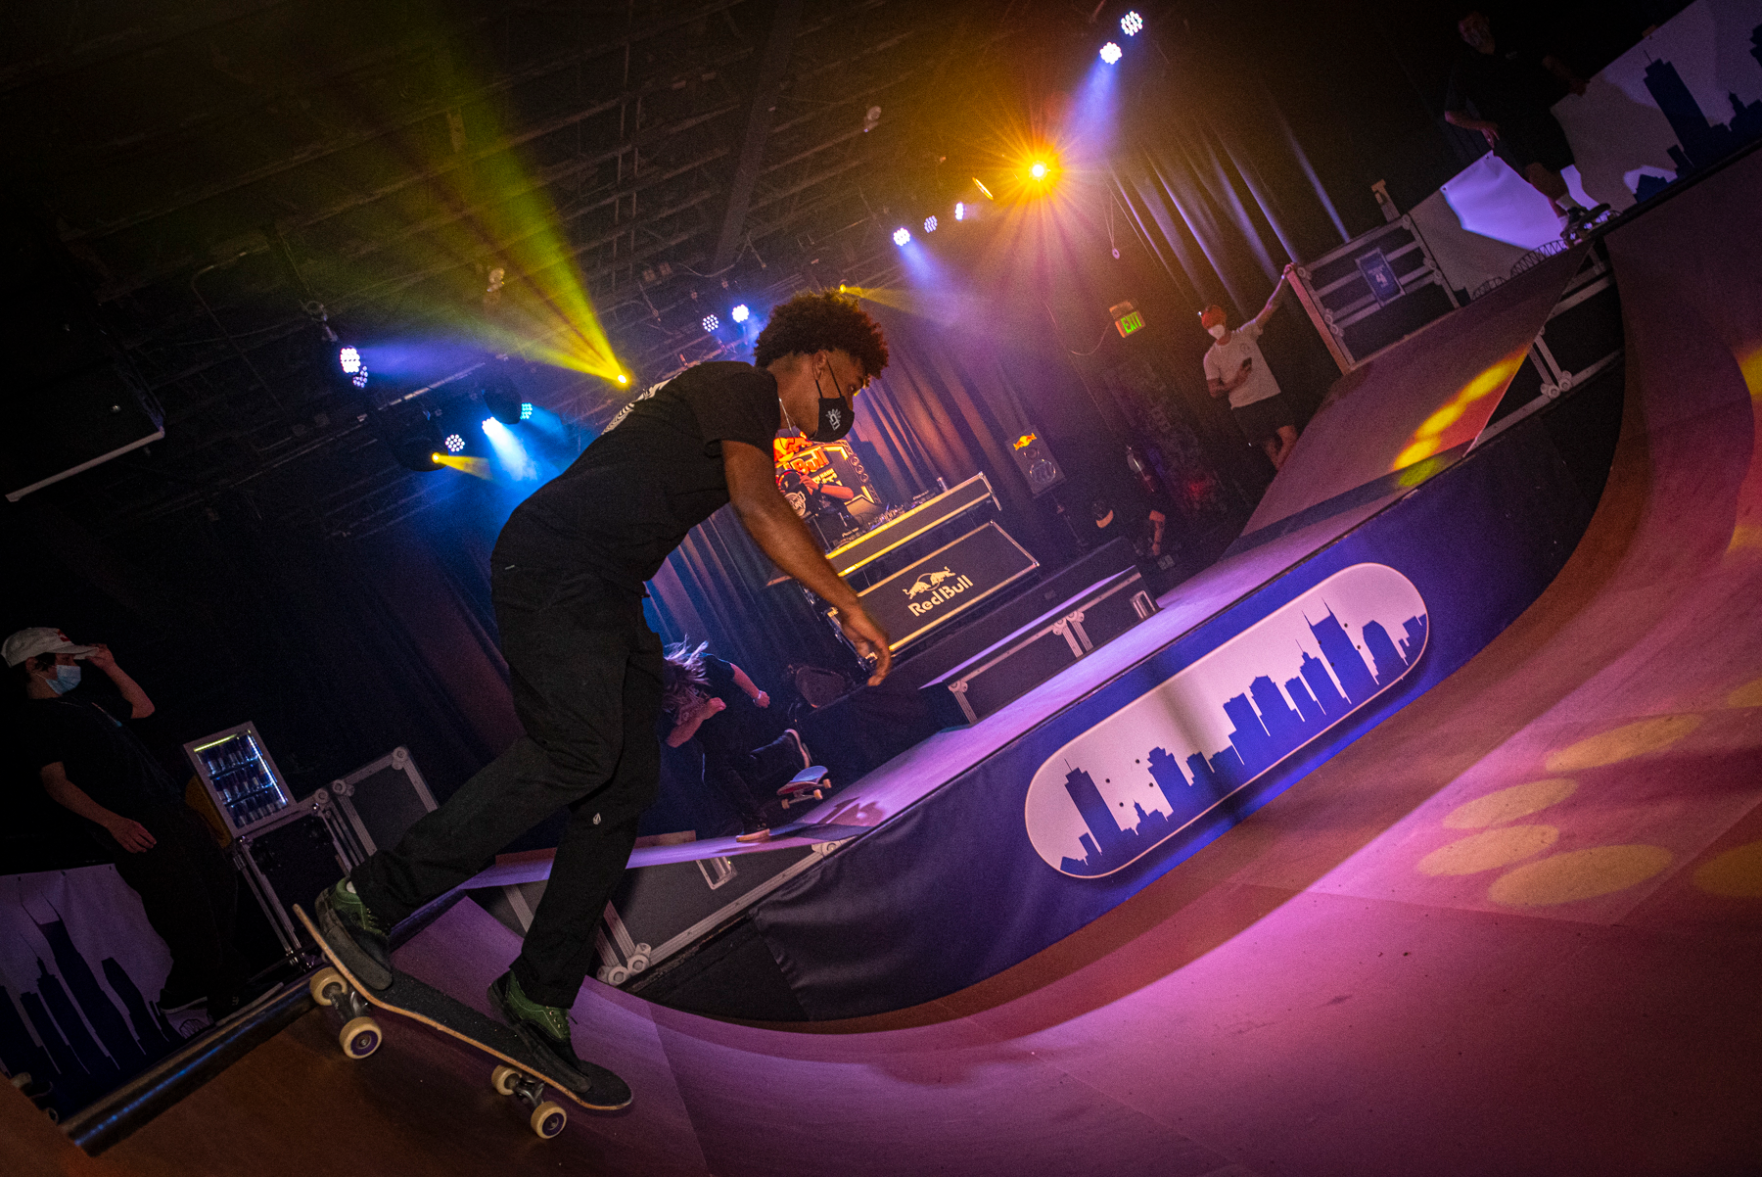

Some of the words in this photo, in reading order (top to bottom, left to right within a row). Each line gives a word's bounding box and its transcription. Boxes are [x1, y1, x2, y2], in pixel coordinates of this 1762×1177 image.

[1121, 311, 1142, 334] EXIT
[790, 450, 829, 475] Bull
[908, 590, 944, 617] Red
[938, 574, 974, 600] Bull
